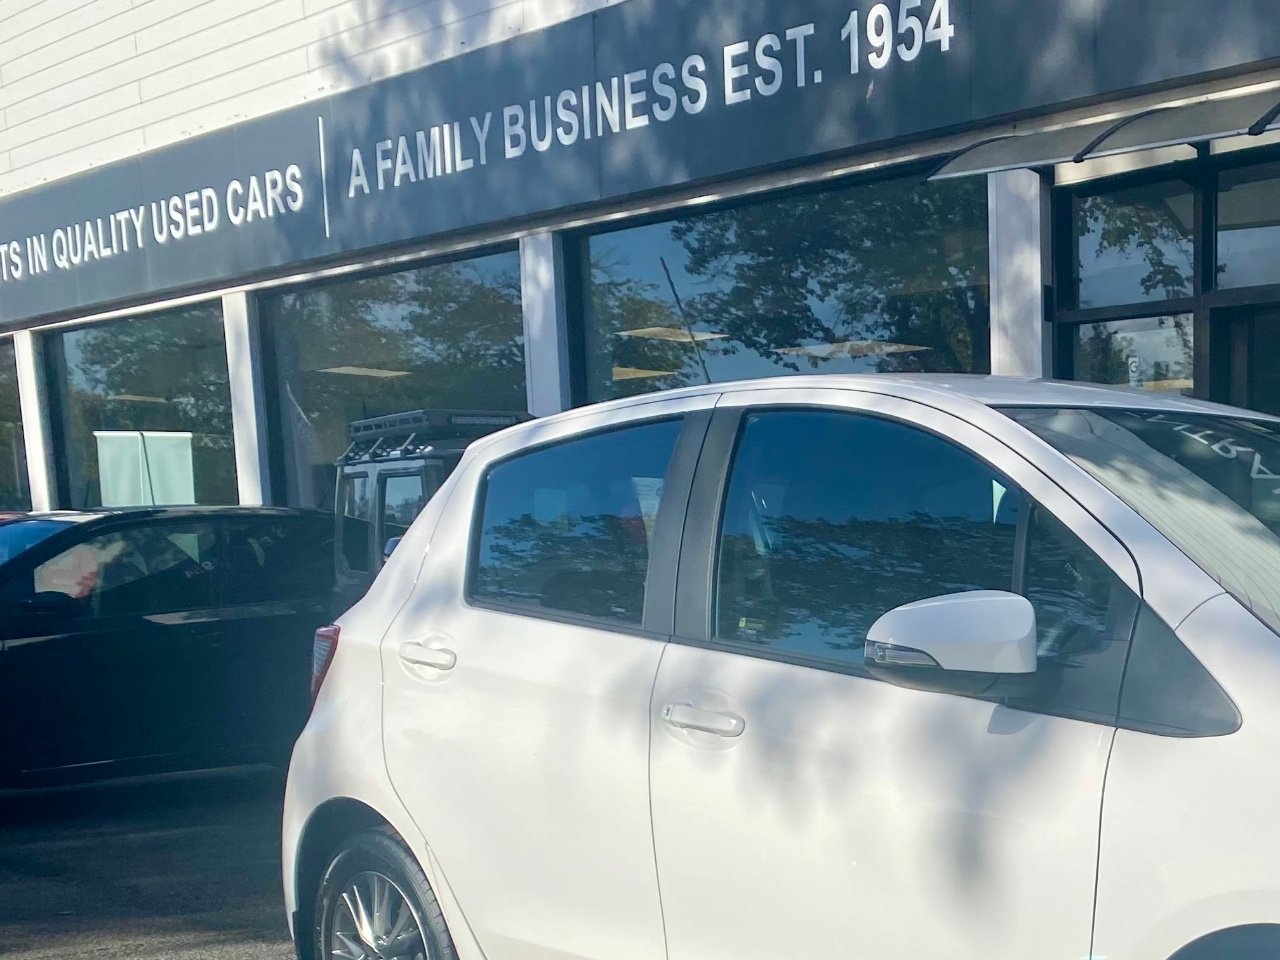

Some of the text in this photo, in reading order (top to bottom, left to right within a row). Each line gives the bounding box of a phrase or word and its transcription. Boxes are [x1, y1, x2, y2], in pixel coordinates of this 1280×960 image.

[347, 0, 955, 198] A FAMILY BUSINESS EST. 1954
[26, 233, 48, 276] IN
[51, 205, 146, 270] QUALITY
[151, 187, 219, 245] USED
[226, 164, 305, 226] CARS
